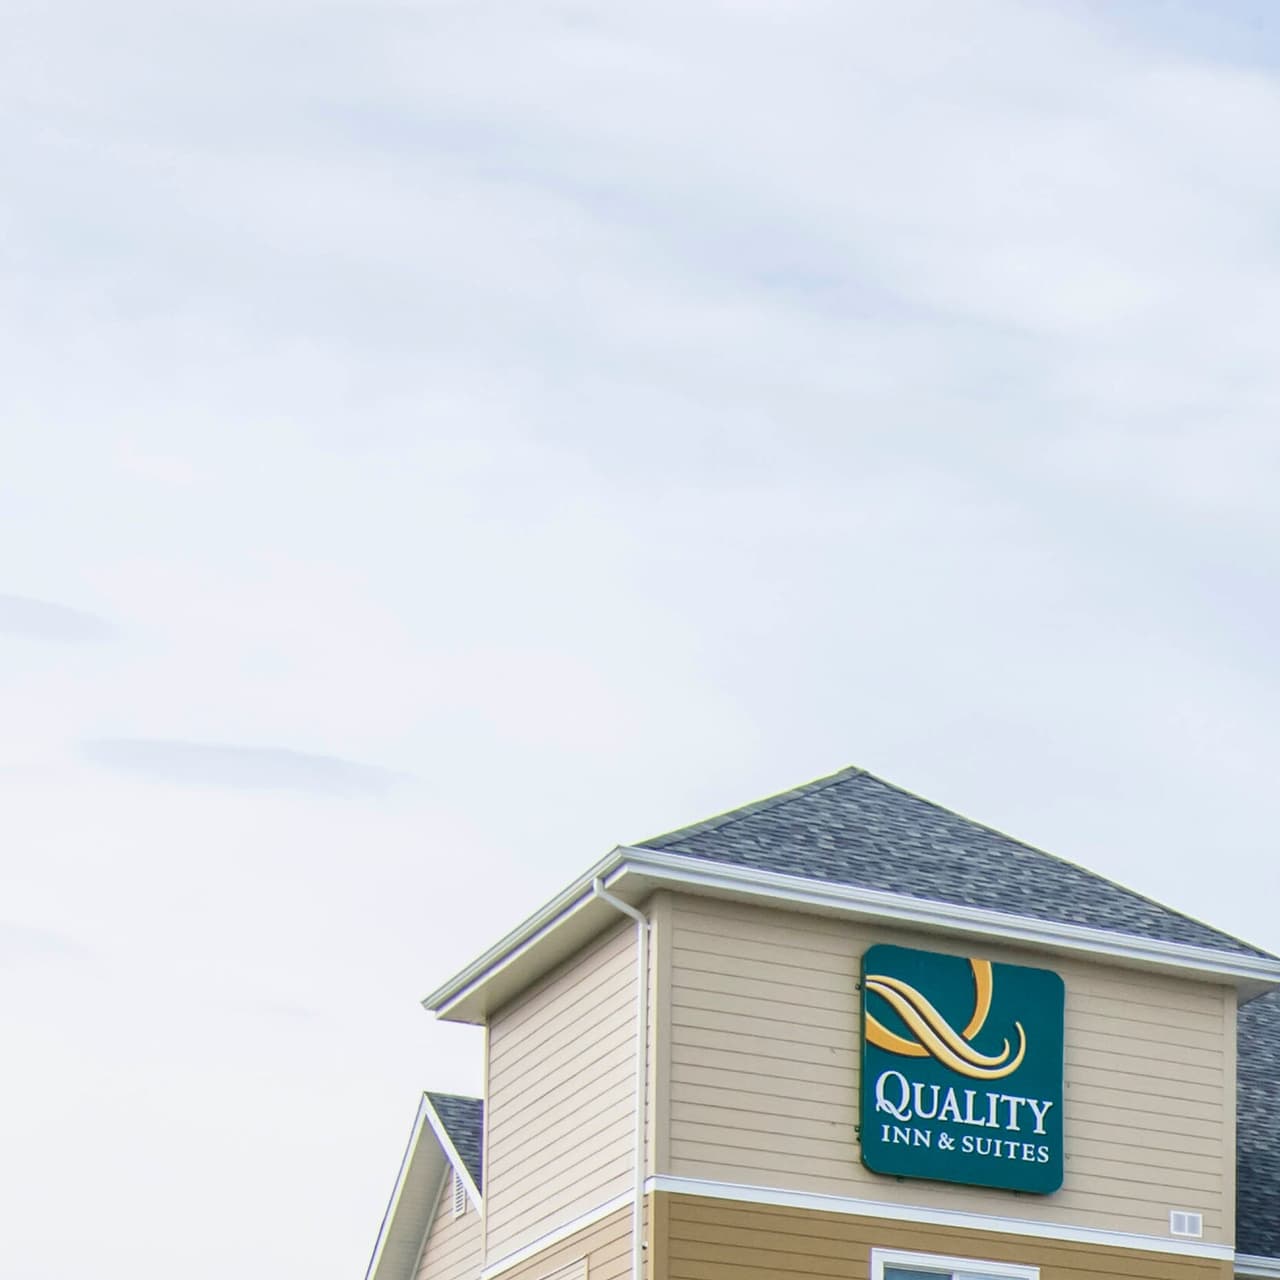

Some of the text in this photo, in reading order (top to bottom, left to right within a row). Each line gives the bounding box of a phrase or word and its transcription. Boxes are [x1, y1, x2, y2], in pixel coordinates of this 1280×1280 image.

[875, 1070, 1053, 1135] QUALITY
[881, 1124, 1049, 1163] INN & SUITES
